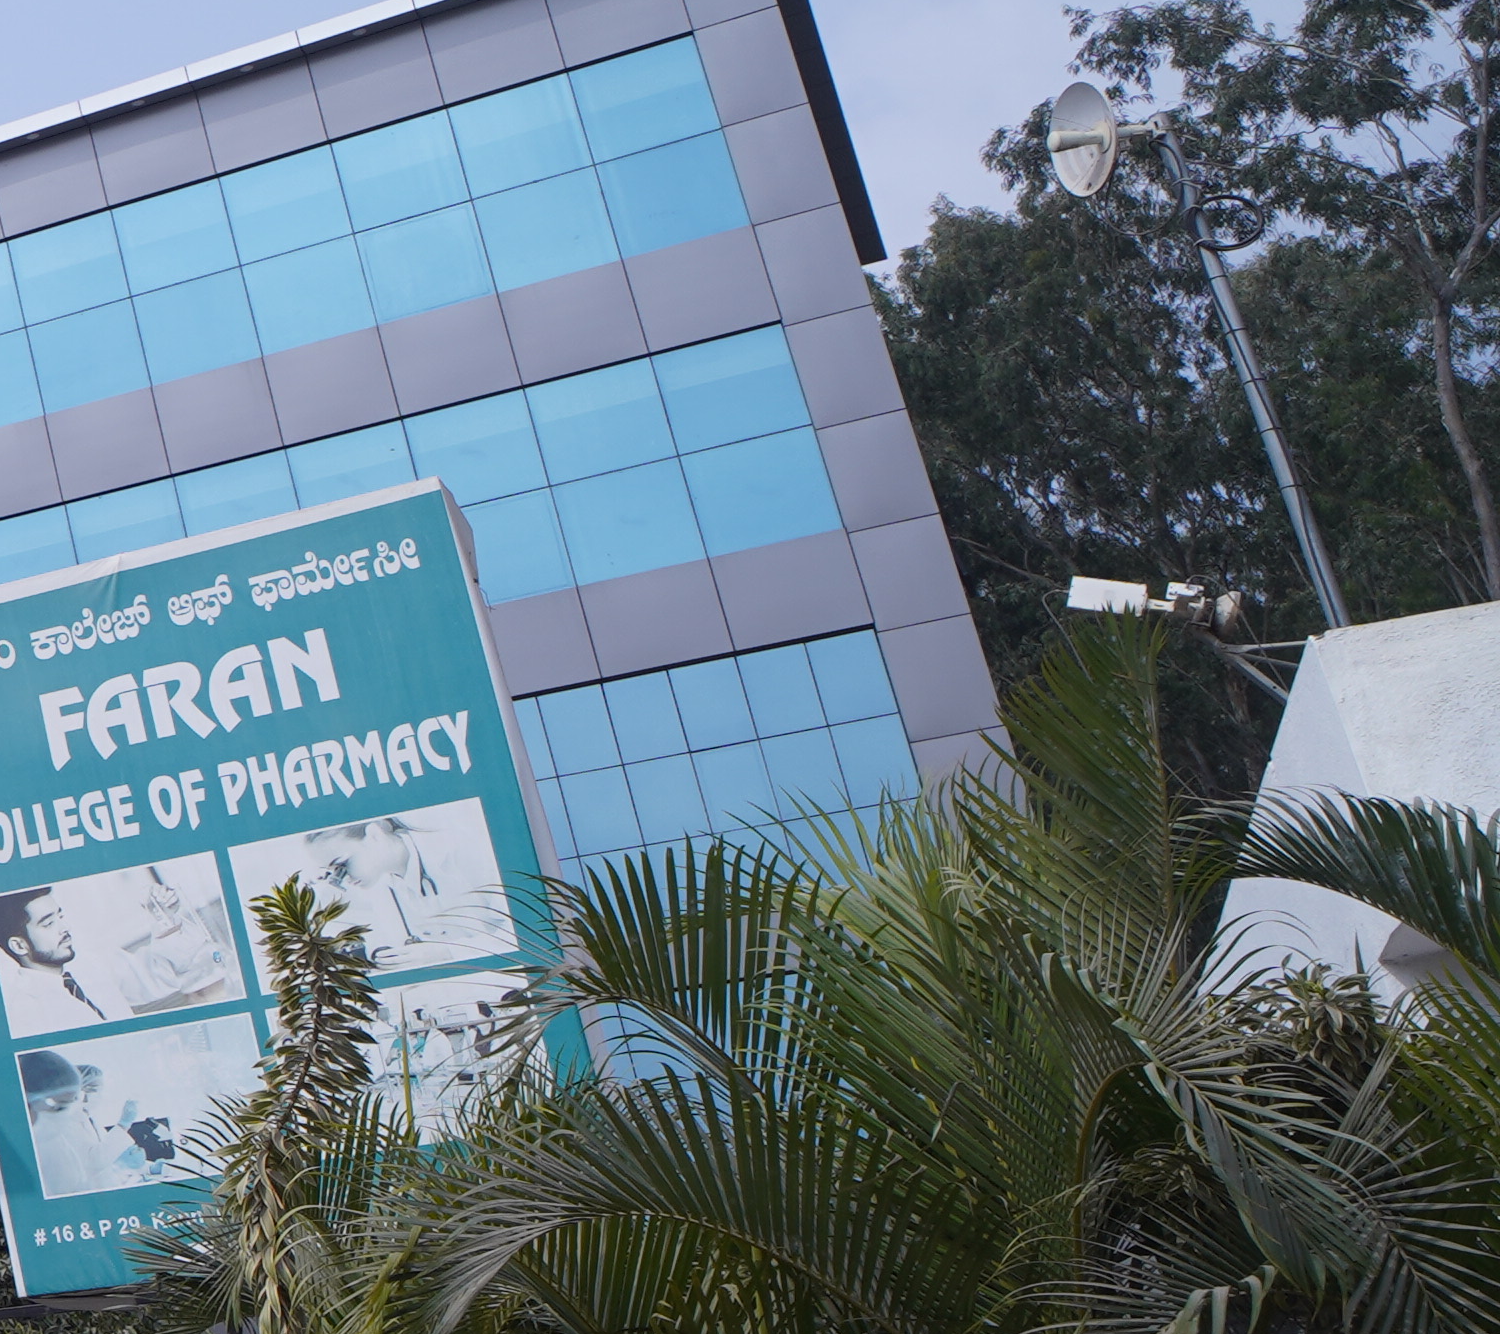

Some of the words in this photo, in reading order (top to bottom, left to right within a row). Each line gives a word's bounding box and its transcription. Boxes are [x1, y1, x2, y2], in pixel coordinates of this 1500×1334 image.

[30, 595, 151, 660] ಕಾಲೇಜ್
[38, 628, 340, 772] FARAN
[147, 770, 207, 832] OF
[219, 710, 472, 817] PHARMACY
[34, 1228, 48, 1246] #
[52, 1225, 74, 1243] 16
[79, 1223, 95, 1240] &
[99, 1220, 111, 1237] P
